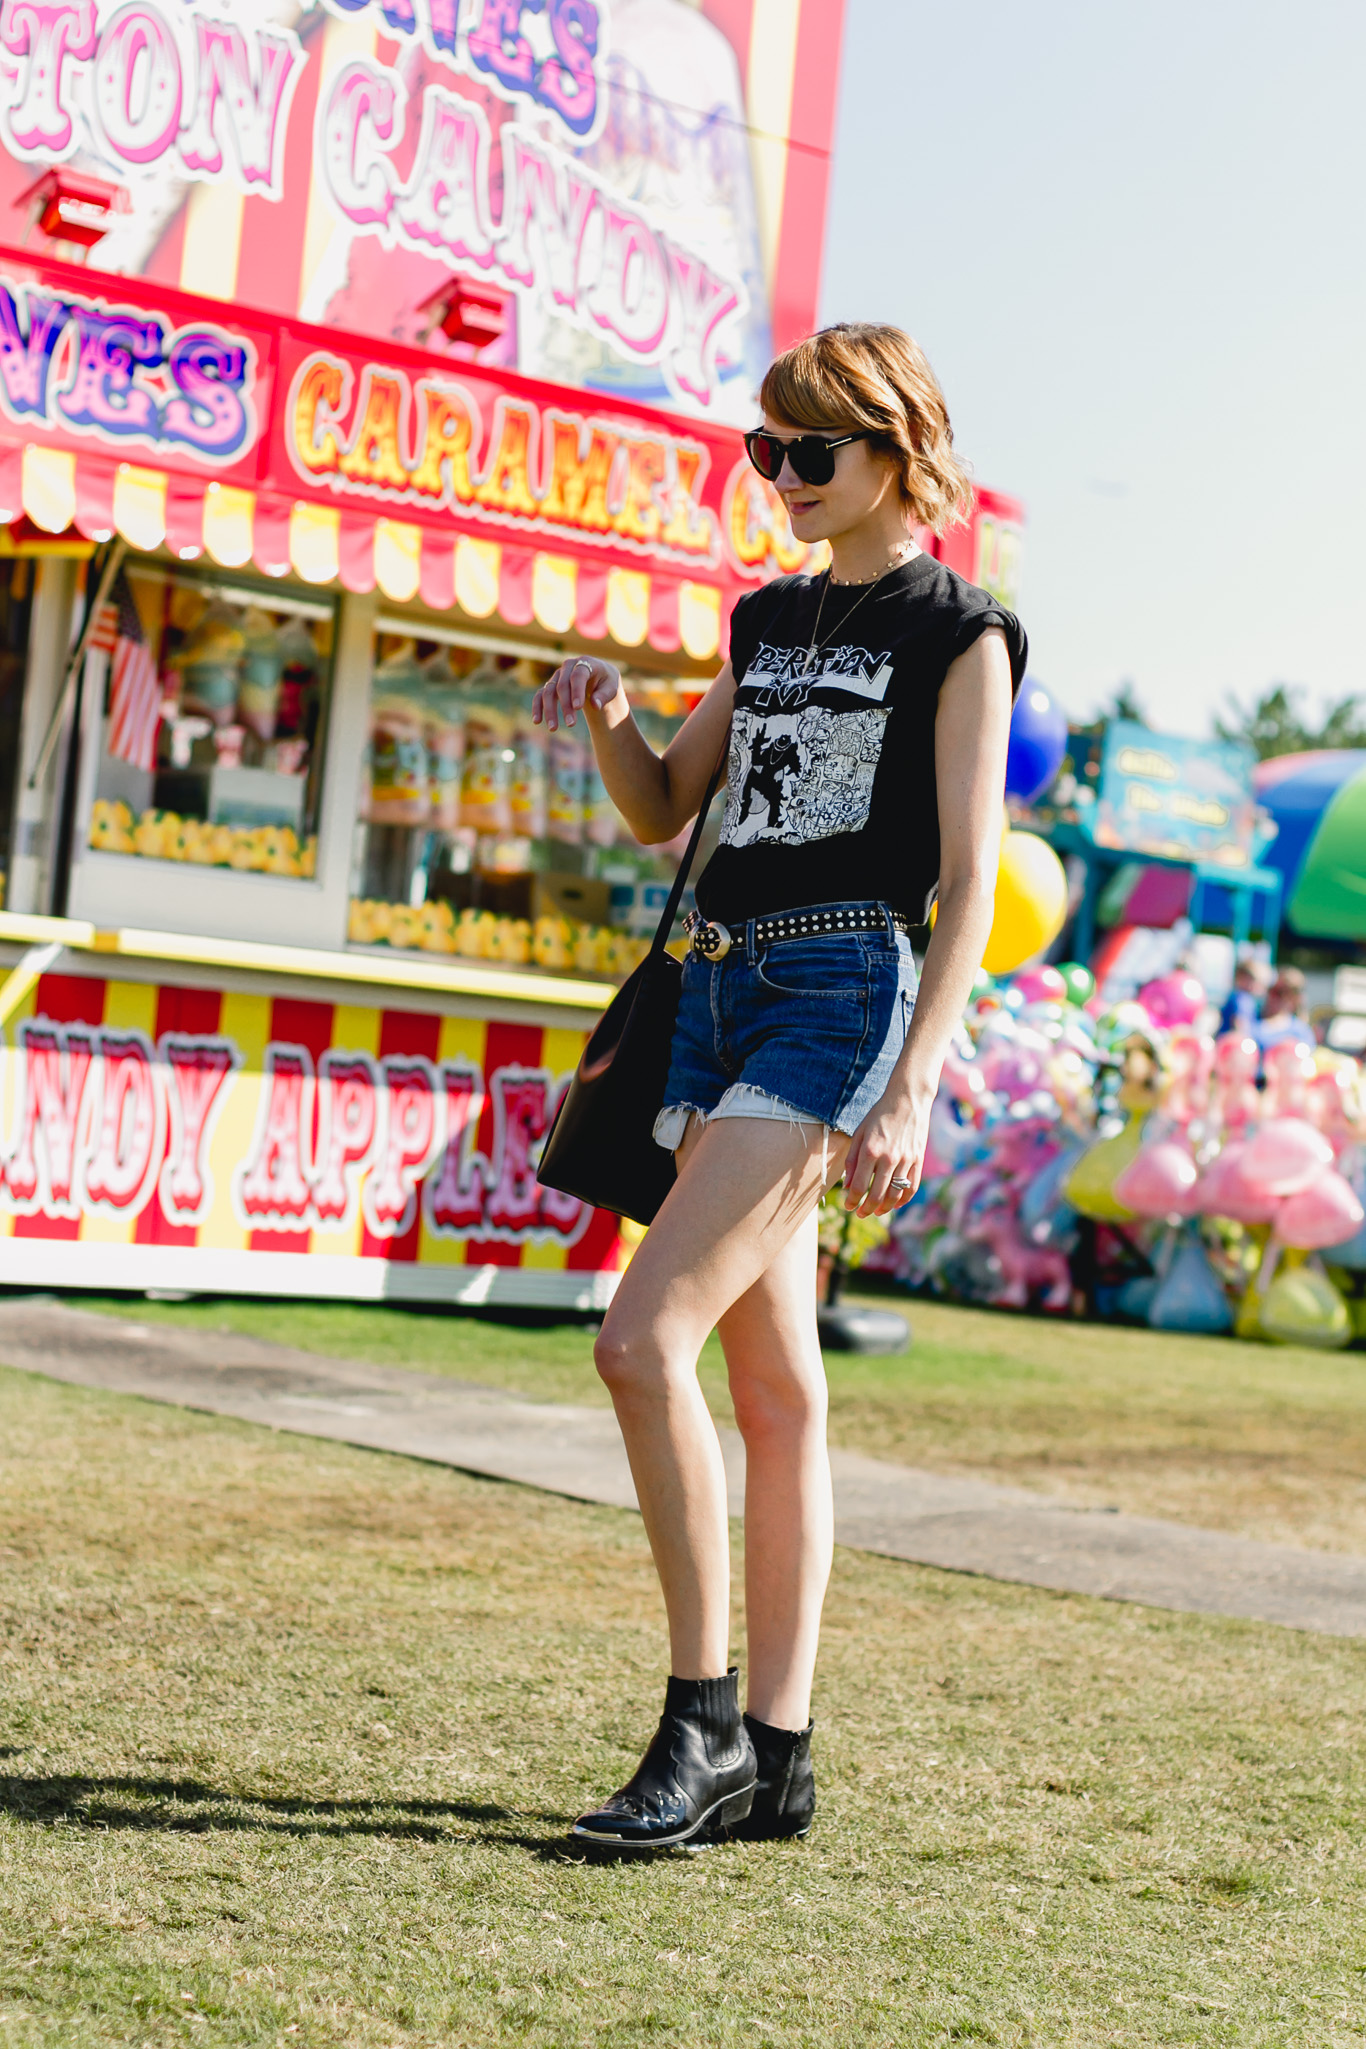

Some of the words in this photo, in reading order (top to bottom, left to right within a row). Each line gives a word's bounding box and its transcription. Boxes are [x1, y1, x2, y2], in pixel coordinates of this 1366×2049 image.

[320, 0, 600, 136] ES
[0, 0, 297, 188] TON
[318, 63, 742, 405] CANDY
[292, 357, 716, 558] CARAMEL
[243, 1051, 588, 1237] APPLE
